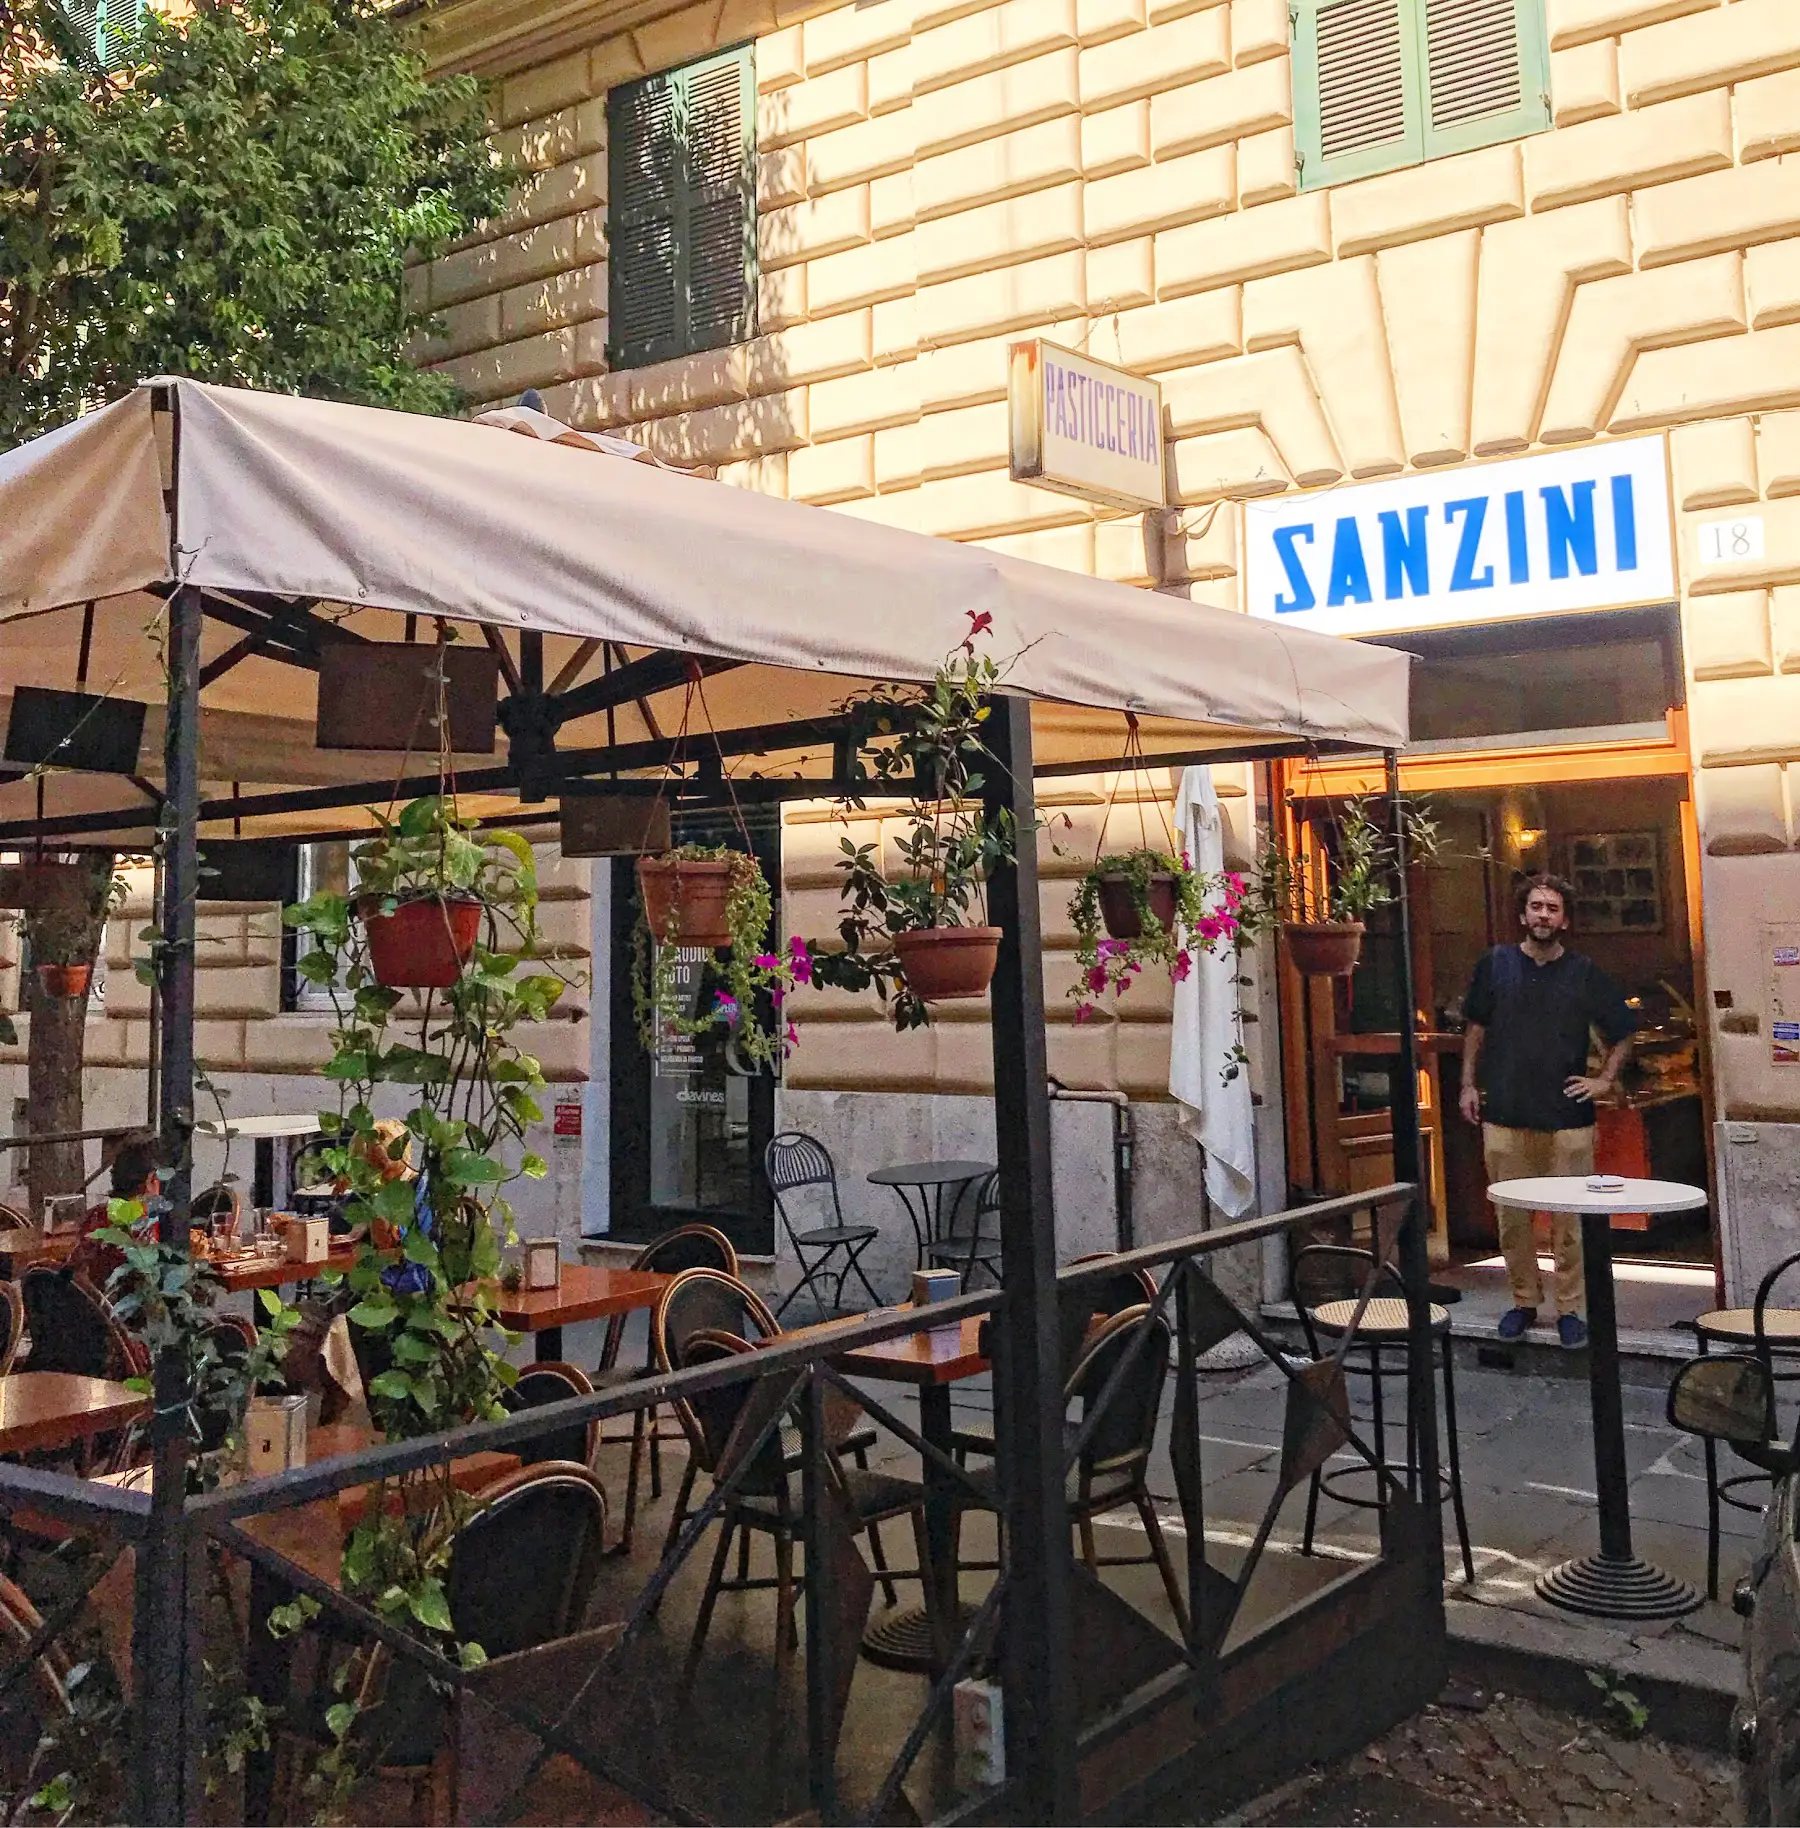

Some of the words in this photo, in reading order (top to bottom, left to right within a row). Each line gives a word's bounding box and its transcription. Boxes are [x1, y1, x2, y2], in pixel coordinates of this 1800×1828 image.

[1045, 361, 1158, 466] PASTICCERIA
[1272, 473, 1638, 614] SANZINI
[1714, 523, 1750, 558] 18
[676, 1085, 725, 1102] davines
